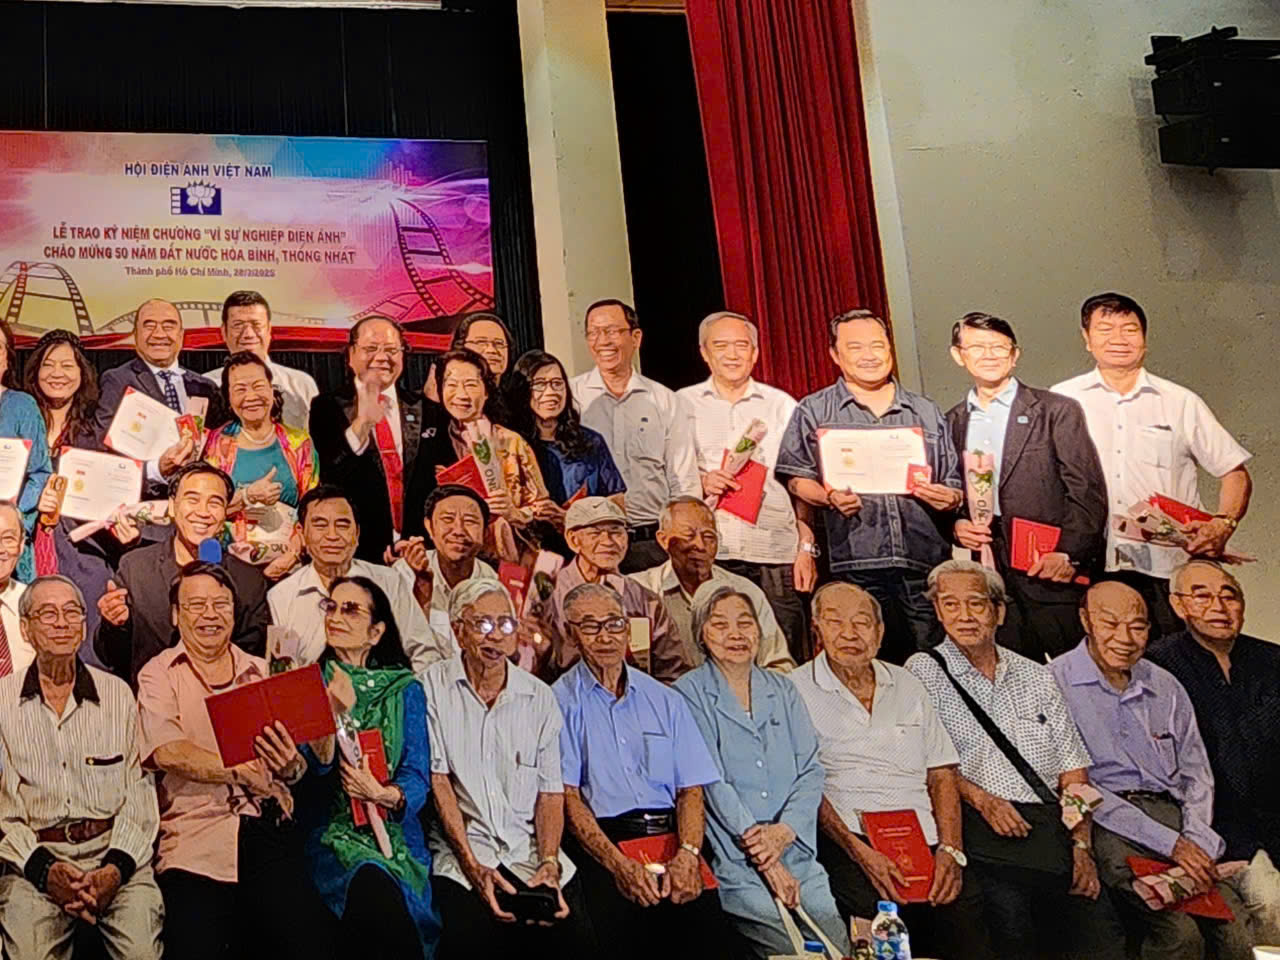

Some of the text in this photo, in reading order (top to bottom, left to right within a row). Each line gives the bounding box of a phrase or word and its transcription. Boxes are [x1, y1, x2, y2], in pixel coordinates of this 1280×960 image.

[125, 161, 272, 180] HỘI ĐIỆN ẢNH VIỆT NAM
[70, 226, 100, 240] TRAO
[121, 224, 150, 243] NIỆM
[243, 227, 285, 246] NGHIỆP
[43, 243, 76, 259] CHÀO
[115, 246, 129, 259] 50
[131, 245, 157, 260] NĂM
[160, 242, 183, 260] ĐẤT
